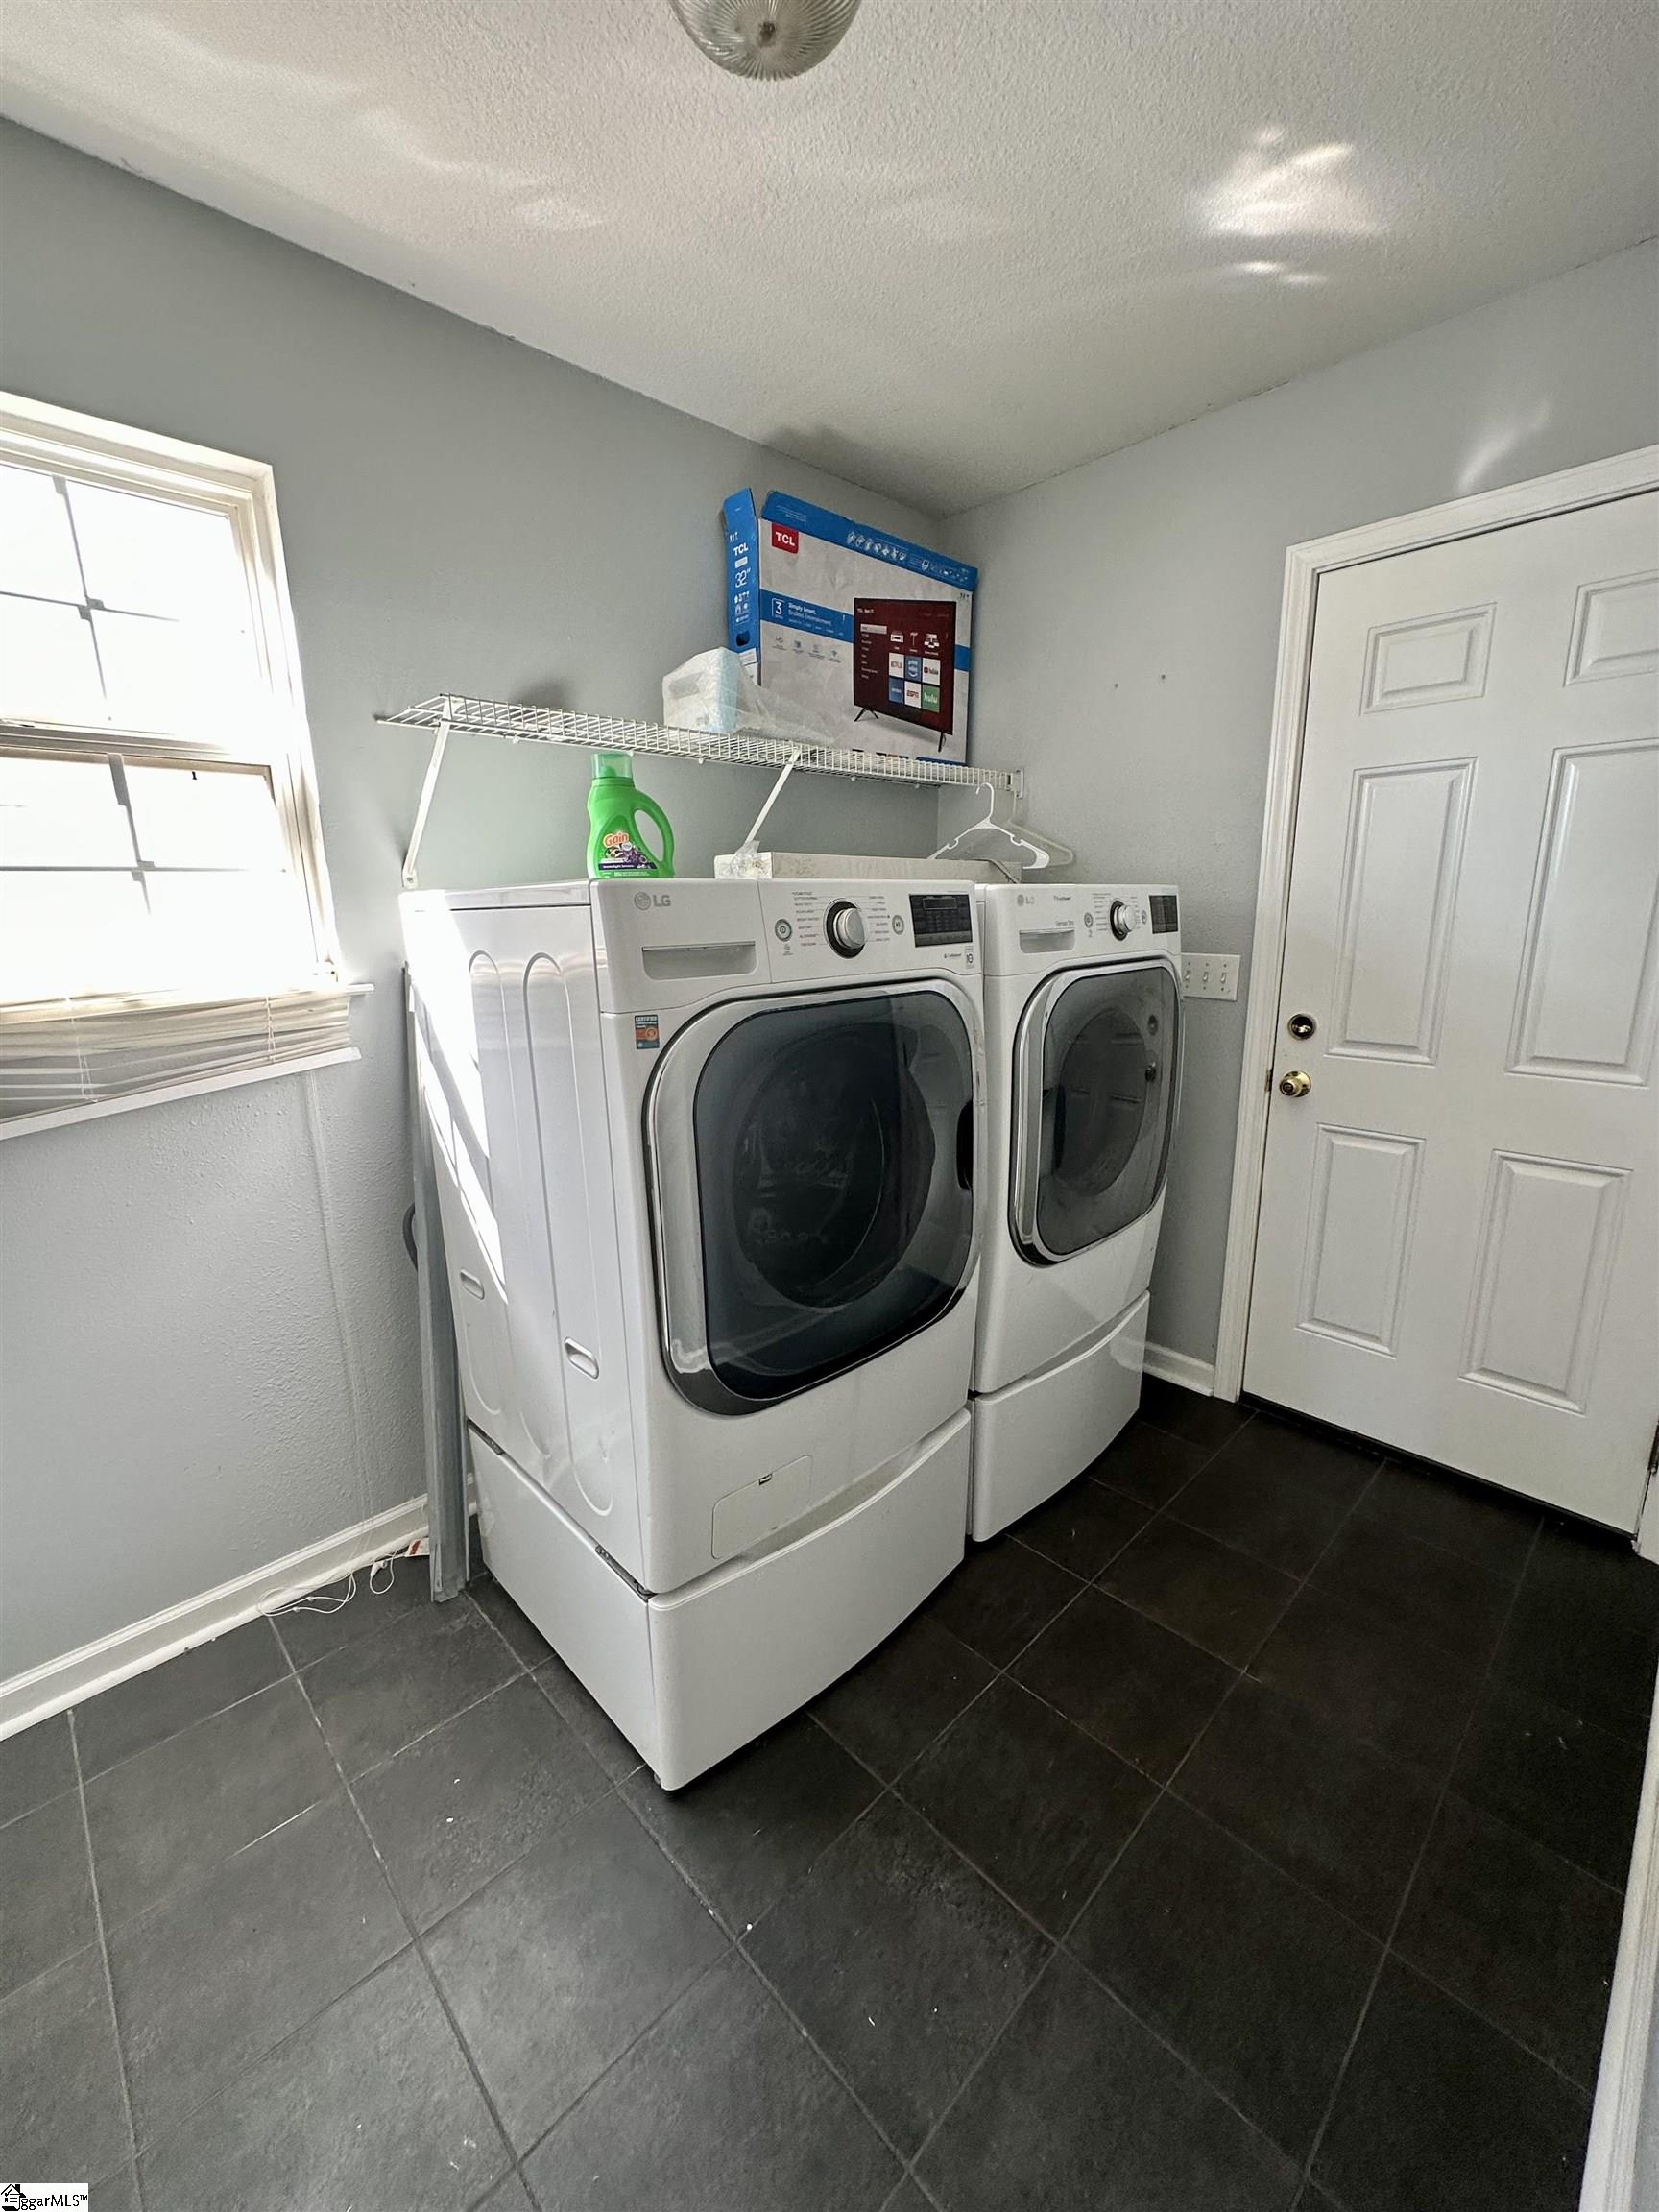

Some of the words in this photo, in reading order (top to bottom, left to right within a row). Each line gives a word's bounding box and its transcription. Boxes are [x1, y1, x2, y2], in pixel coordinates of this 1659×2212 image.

[775, 531, 796, 547] TCL
[733, 542, 749, 556] TCL
[775, 601, 782, 615] 3
[923, 691, 938, 704] hulu
[603, 830, 630, 849] Gain
[653, 894, 671, 907] LG
